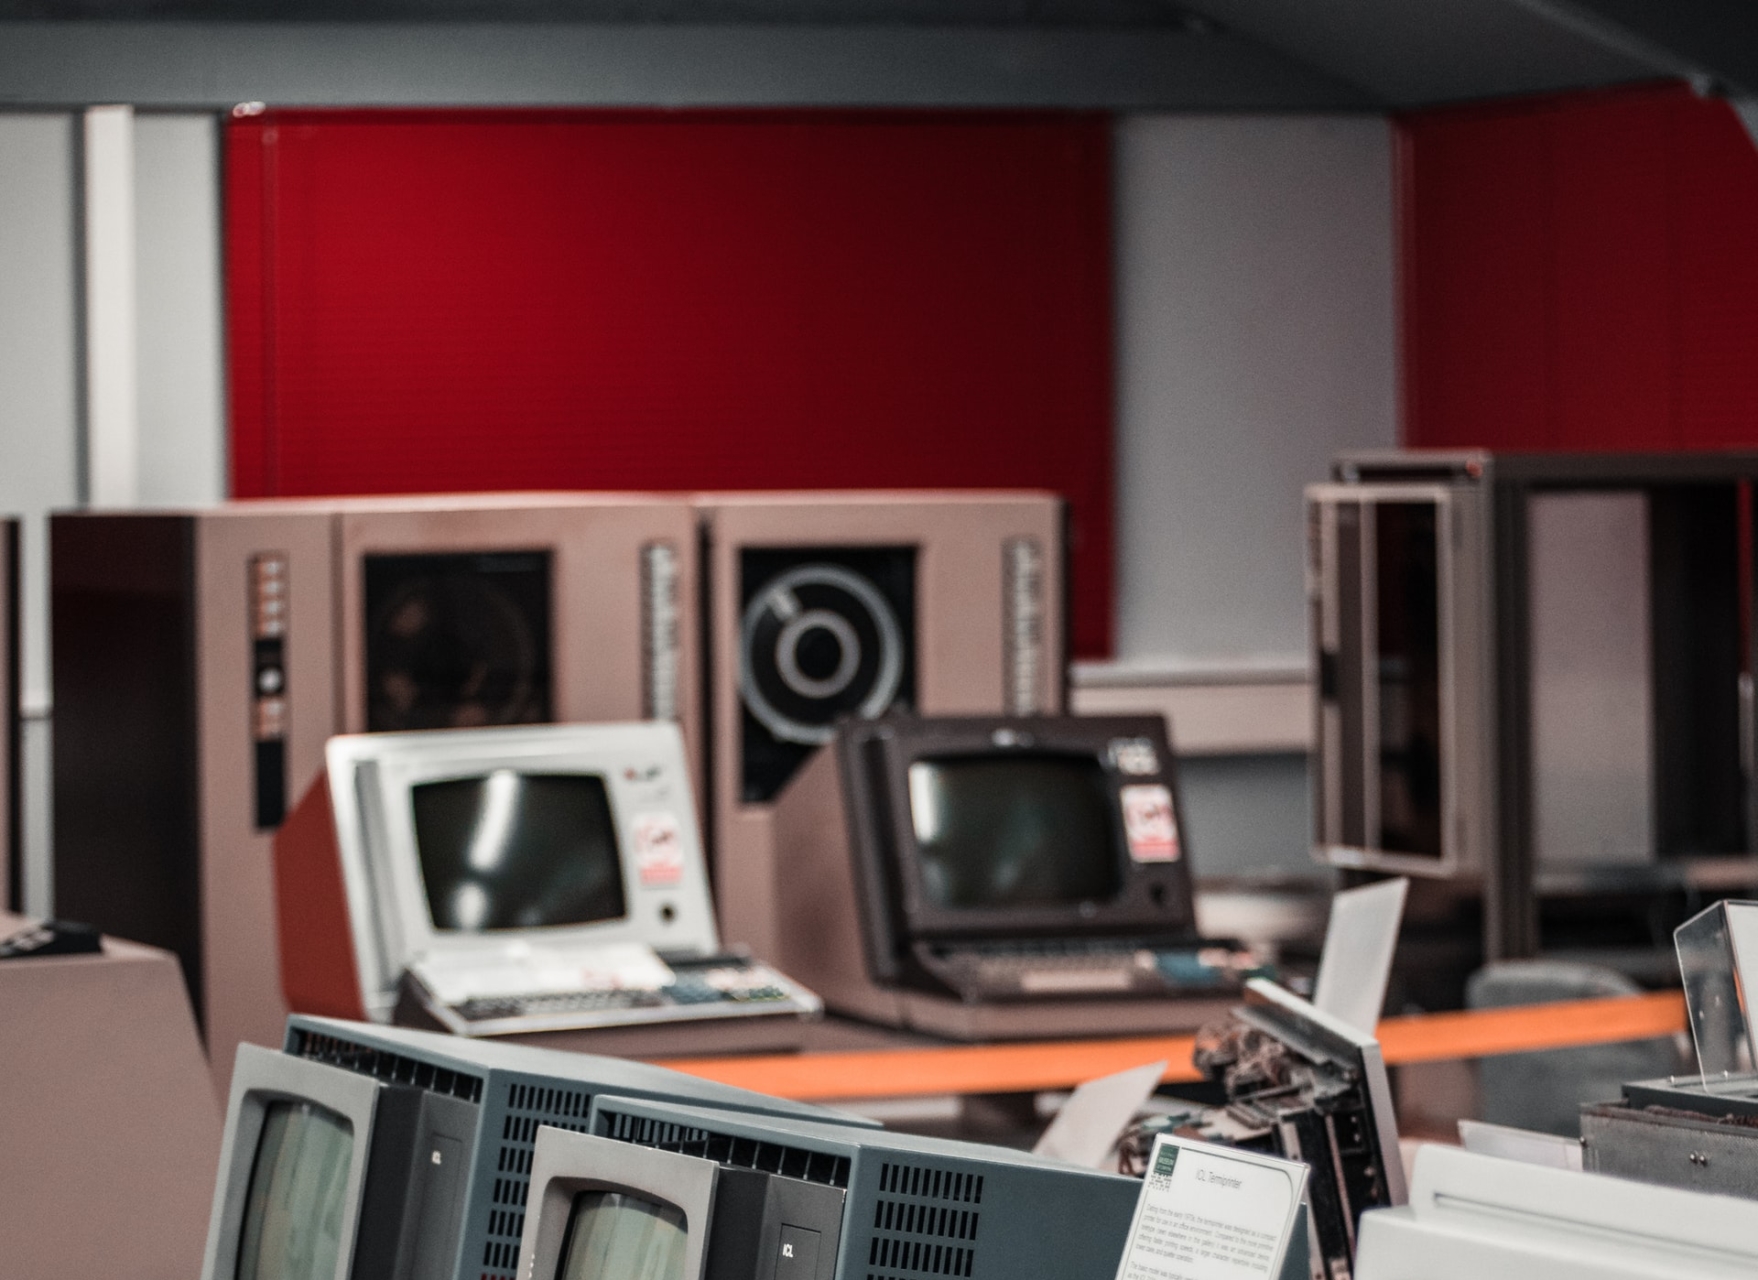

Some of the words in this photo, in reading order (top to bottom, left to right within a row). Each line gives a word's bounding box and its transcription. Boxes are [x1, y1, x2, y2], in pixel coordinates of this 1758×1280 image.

[1195, 1169, 1206, 1182] ICL
[1208, 1171, 1243, 1190] Termiprinter
[782, 1243, 794, 1258] ICL
